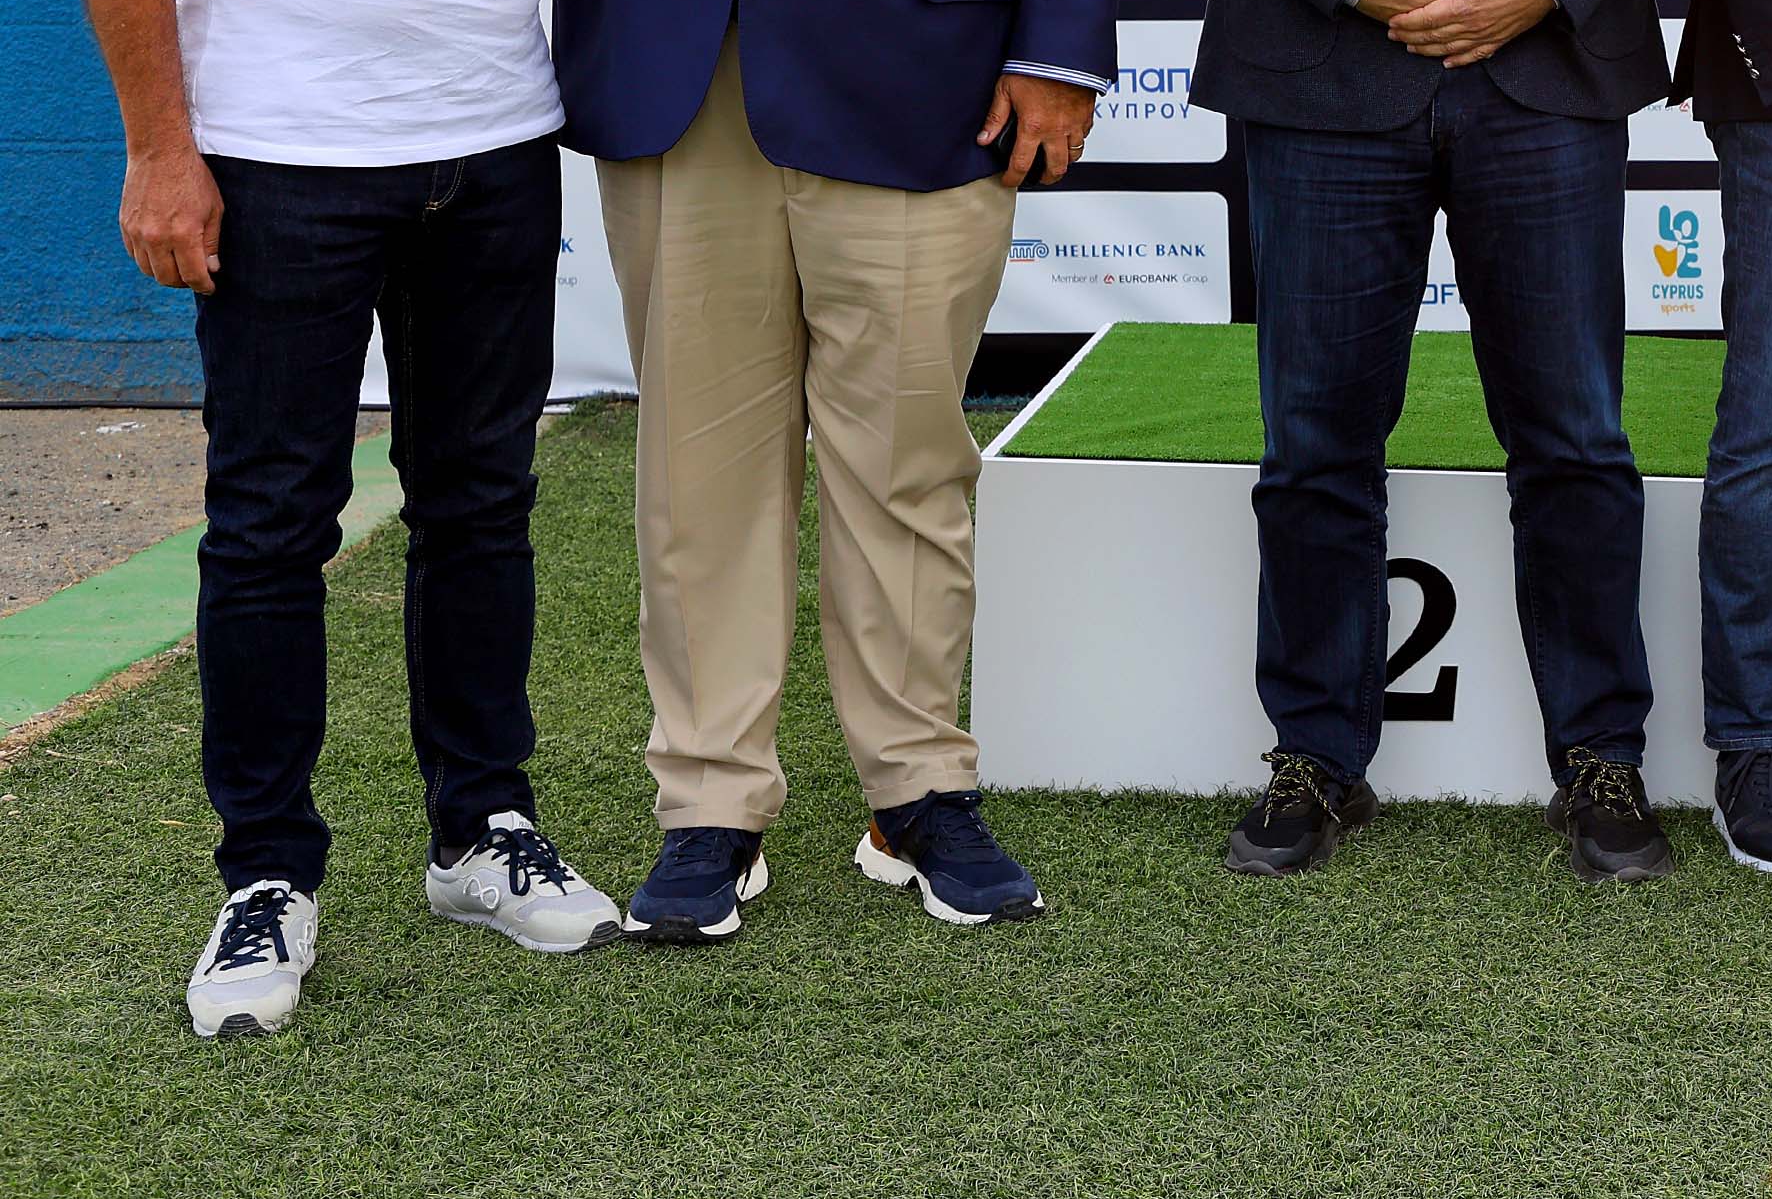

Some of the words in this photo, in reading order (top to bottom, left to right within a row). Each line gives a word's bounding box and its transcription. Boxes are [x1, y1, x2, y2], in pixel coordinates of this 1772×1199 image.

[1055, 244, 1147, 258] HELLENIC
[1155, 244, 1206, 258] BANK
[1051, 273, 1087, 283] Member
[1089, 273, 1099, 283] of
[1118, 274, 1178, 284] EUROBANK
[1182, 274, 1209, 285] Group
[1652, 284, 1704, 299] CYPRUS
[1660, 303, 1696, 315] sports
[1383, 557, 1459, 721] 2
